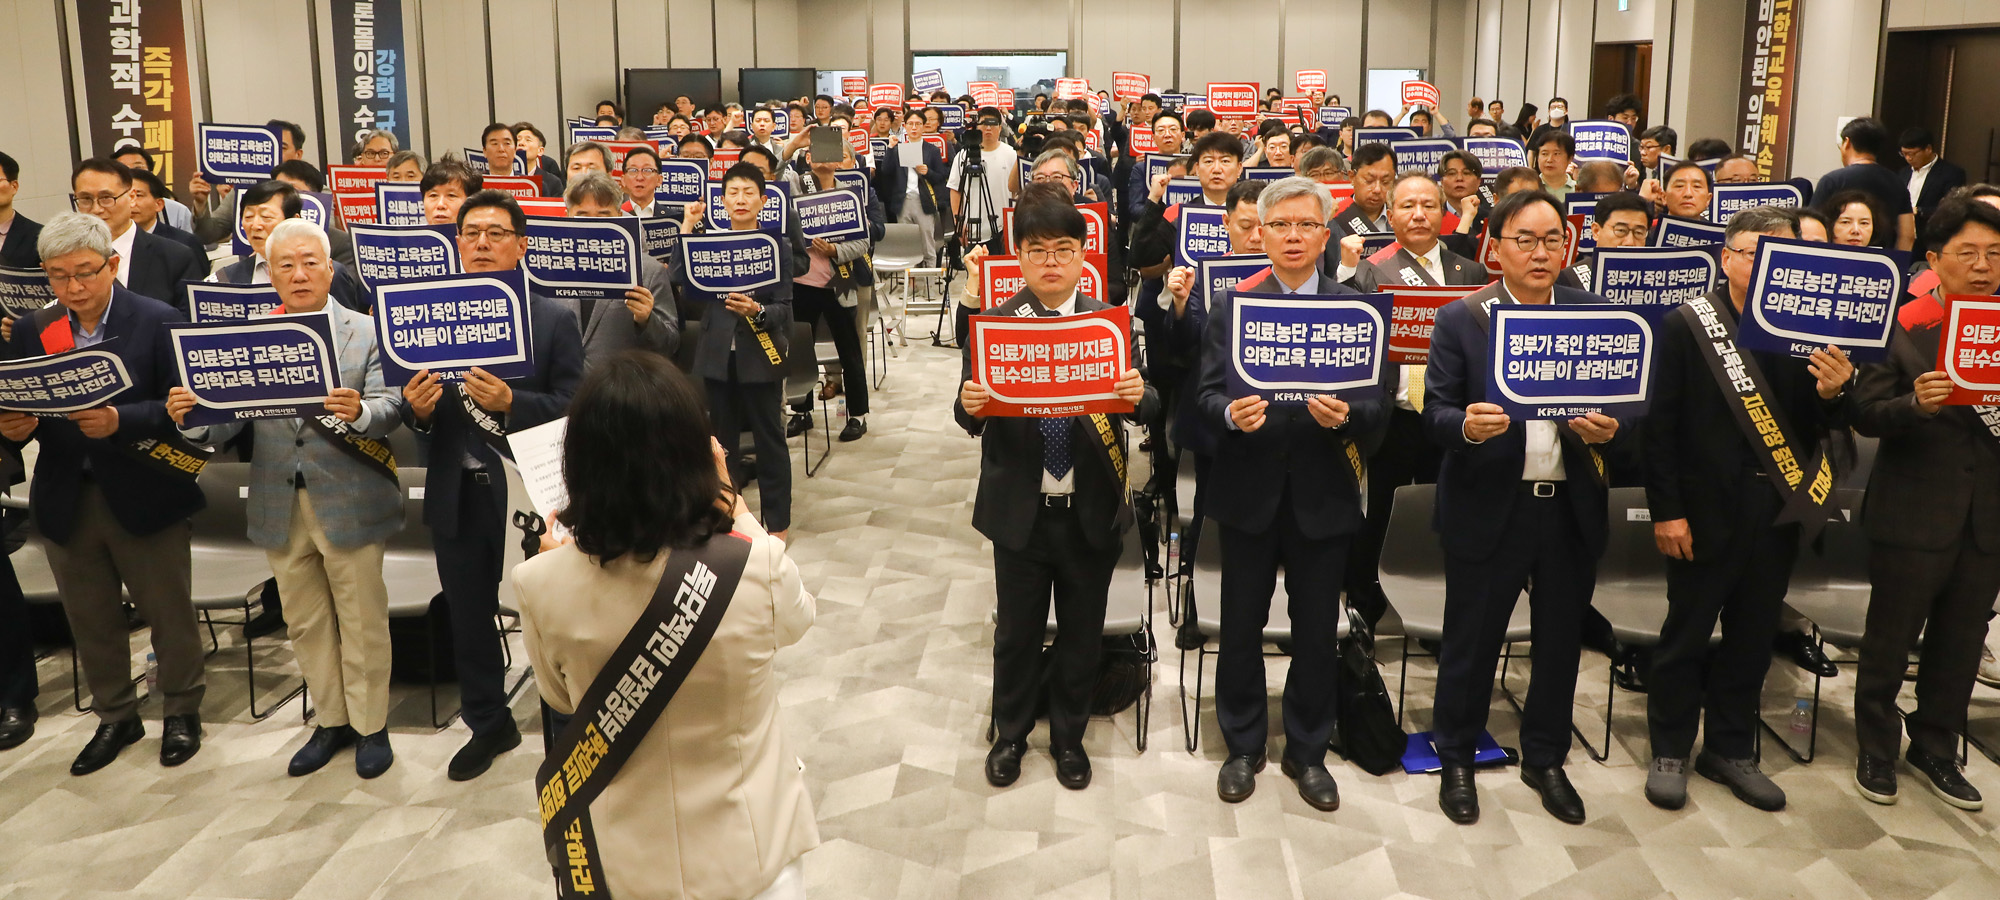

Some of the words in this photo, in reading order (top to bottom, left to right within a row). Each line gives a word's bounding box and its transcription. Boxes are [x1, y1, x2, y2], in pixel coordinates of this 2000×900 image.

[143, 46, 174, 112] 즉각
[375, 49, 396, 103] 강력
[1743, 93, 1765, 161] 의대
[143, 119, 174, 191] 폐기
[208, 138, 240, 151] 의료농단
[240, 139, 273, 153] 교육농단
[208, 151, 240, 165] 의학교육
[240, 153, 273, 166] 무너진다
[670, 172, 699, 184] 교육농단
[670, 184, 700, 195] 무너진다
[1188, 222, 1229, 238] 의료농단
[359, 245, 396, 263] 의료농단
[398, 246, 445, 263] 교육농단
[526, 236, 575, 253] 의료농단
[576, 239, 626, 255] 교육농단
[691, 249, 731, 263] 의료농단
[732, 245, 773, 260] 교육농단
[1187, 238, 1228, 253] 의학교육
[362, 264, 399, 280] 의학교육
[528, 254, 577, 271] 의학교육
[578, 256, 627, 273] 무너진다
[693, 264, 733, 279] 의학교육
[734, 259, 773, 276] 무너진다
[1606, 269, 1642, 287] 정부가
[1643, 269, 1667, 287] 죽인
[1667, 266, 1708, 286] 한국의료
[1769, 267, 1838, 295] 의료농단
[1838, 274, 1893, 300] 교육농단
[1605, 288, 1657, 305] 의사들이
[198, 301, 246, 318] 의료농단
[390, 305, 430, 326] 정부가
[431, 302, 457, 322] 죽인
[458, 298, 510, 320] 한국의료
[1764, 292, 1832, 320] 의학교육
[1834, 300, 1886, 325] 무너진다
[393, 327, 453, 349] 의사들이
[453, 322, 512, 344] 살려낸다
[1244, 321, 1308, 344] 의료농단
[1310, 321, 1374, 344] 교육농단
[187, 349, 250, 369] 의료농단
[252, 341, 315, 364] 교육농단
[989, 343, 1051, 362] 의료개악
[1053, 337, 1115, 361] 패키지로
[1243, 345, 1307, 368] 의학교육
[1309, 346, 1371, 368] 무너진다
[1508, 334, 1553, 357] 정부가
[1554, 334, 1583, 356] 죽인
[1586, 333, 1641, 355] 한국의료
[44, 359, 111, 386] 교육농단
[192, 369, 256, 391] 의학교육
[257, 364, 320, 386] 무너진다
[990, 364, 1051, 385] 필수의료
[1054, 361, 1116, 383] 붕괴된다
[1507, 360, 1572, 382] 의사들이
[1574, 358, 1639, 381] 살려낸다
[51, 373, 117, 400] 무너진다
[1274, 392, 1304, 402] KMA
[1712, 339, 1757, 393] 교육농단
[1739, 392, 1786, 448] 지금당장
[1023, 406, 1052, 415] KMA
[1537, 407, 1567, 417] KMA
[645, 560, 718, 666] 독단적인
[598, 653, 663, 743] 갑질정부
[562, 722, 609, 796] 한국의료
